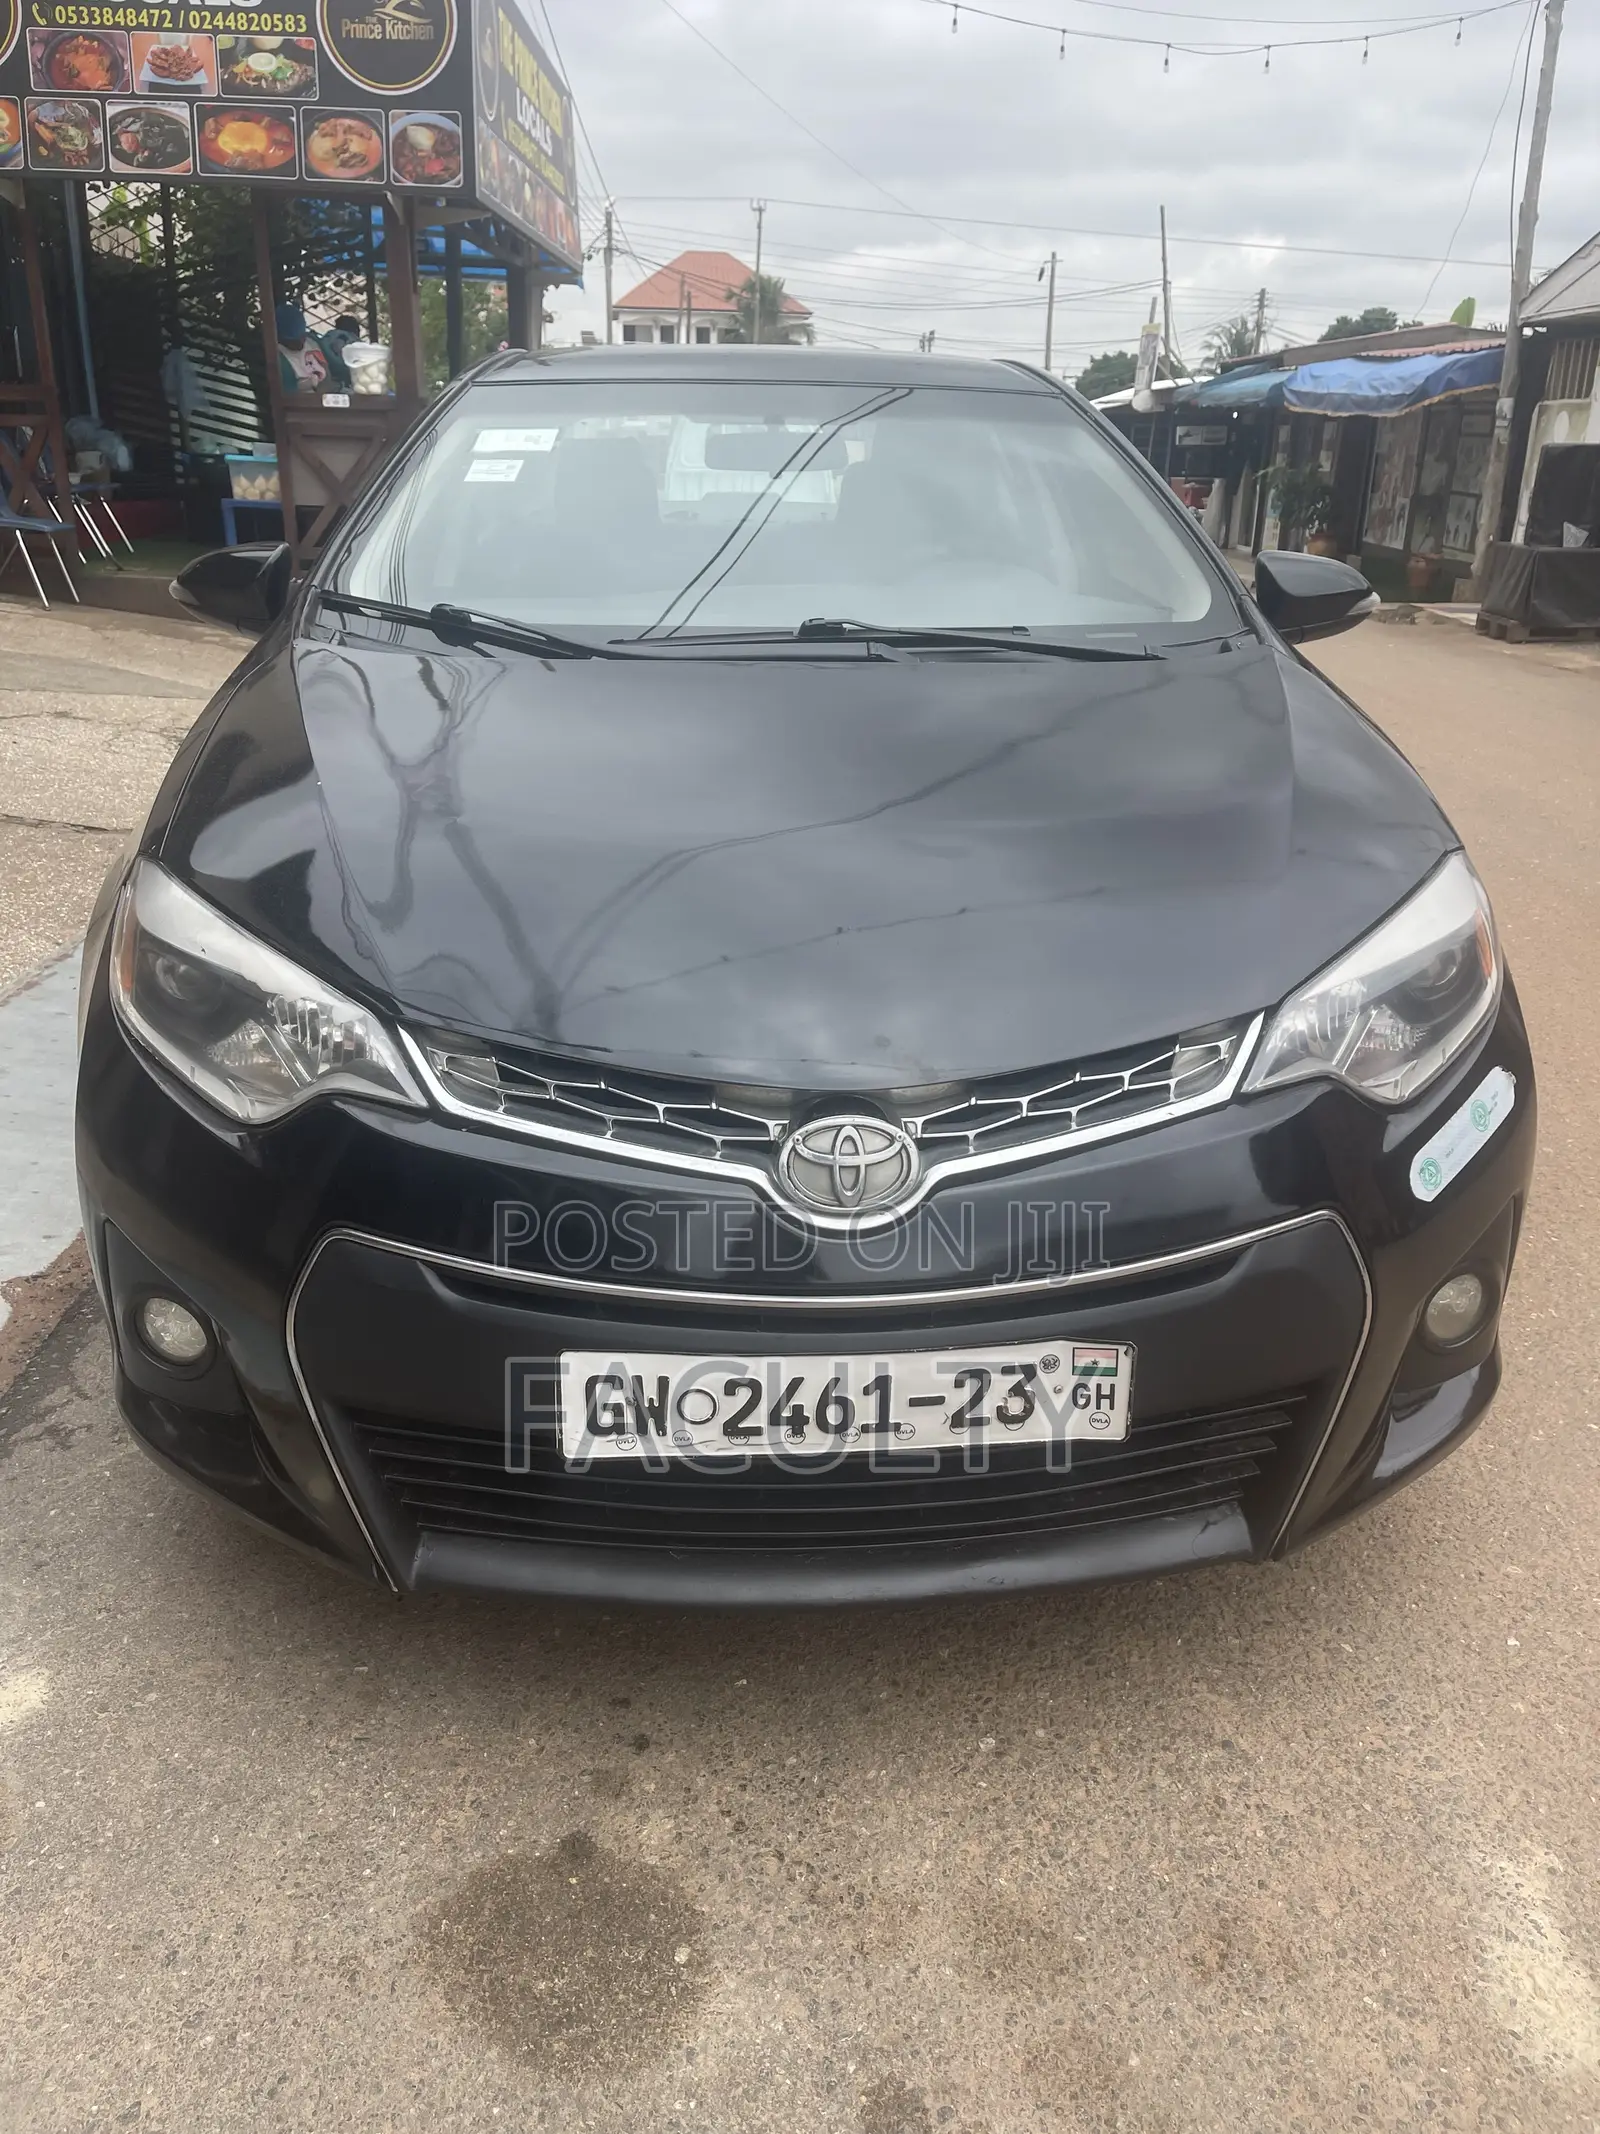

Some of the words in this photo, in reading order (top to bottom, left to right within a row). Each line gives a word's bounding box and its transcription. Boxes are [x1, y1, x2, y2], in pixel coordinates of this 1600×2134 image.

[55, 5, 173, 28] 0533848472
[188, 11, 308, 33] 0244820583
[341, 18, 383, 39] Prince
[385, 19, 435, 41] Kitchen
[515, 86, 553, 157] LOCALS
[584, 1374, 671, 1437] GW
[722, 1363, 1037, 1437] 2461-23
[1071, 1382, 1116, 1410] GH
